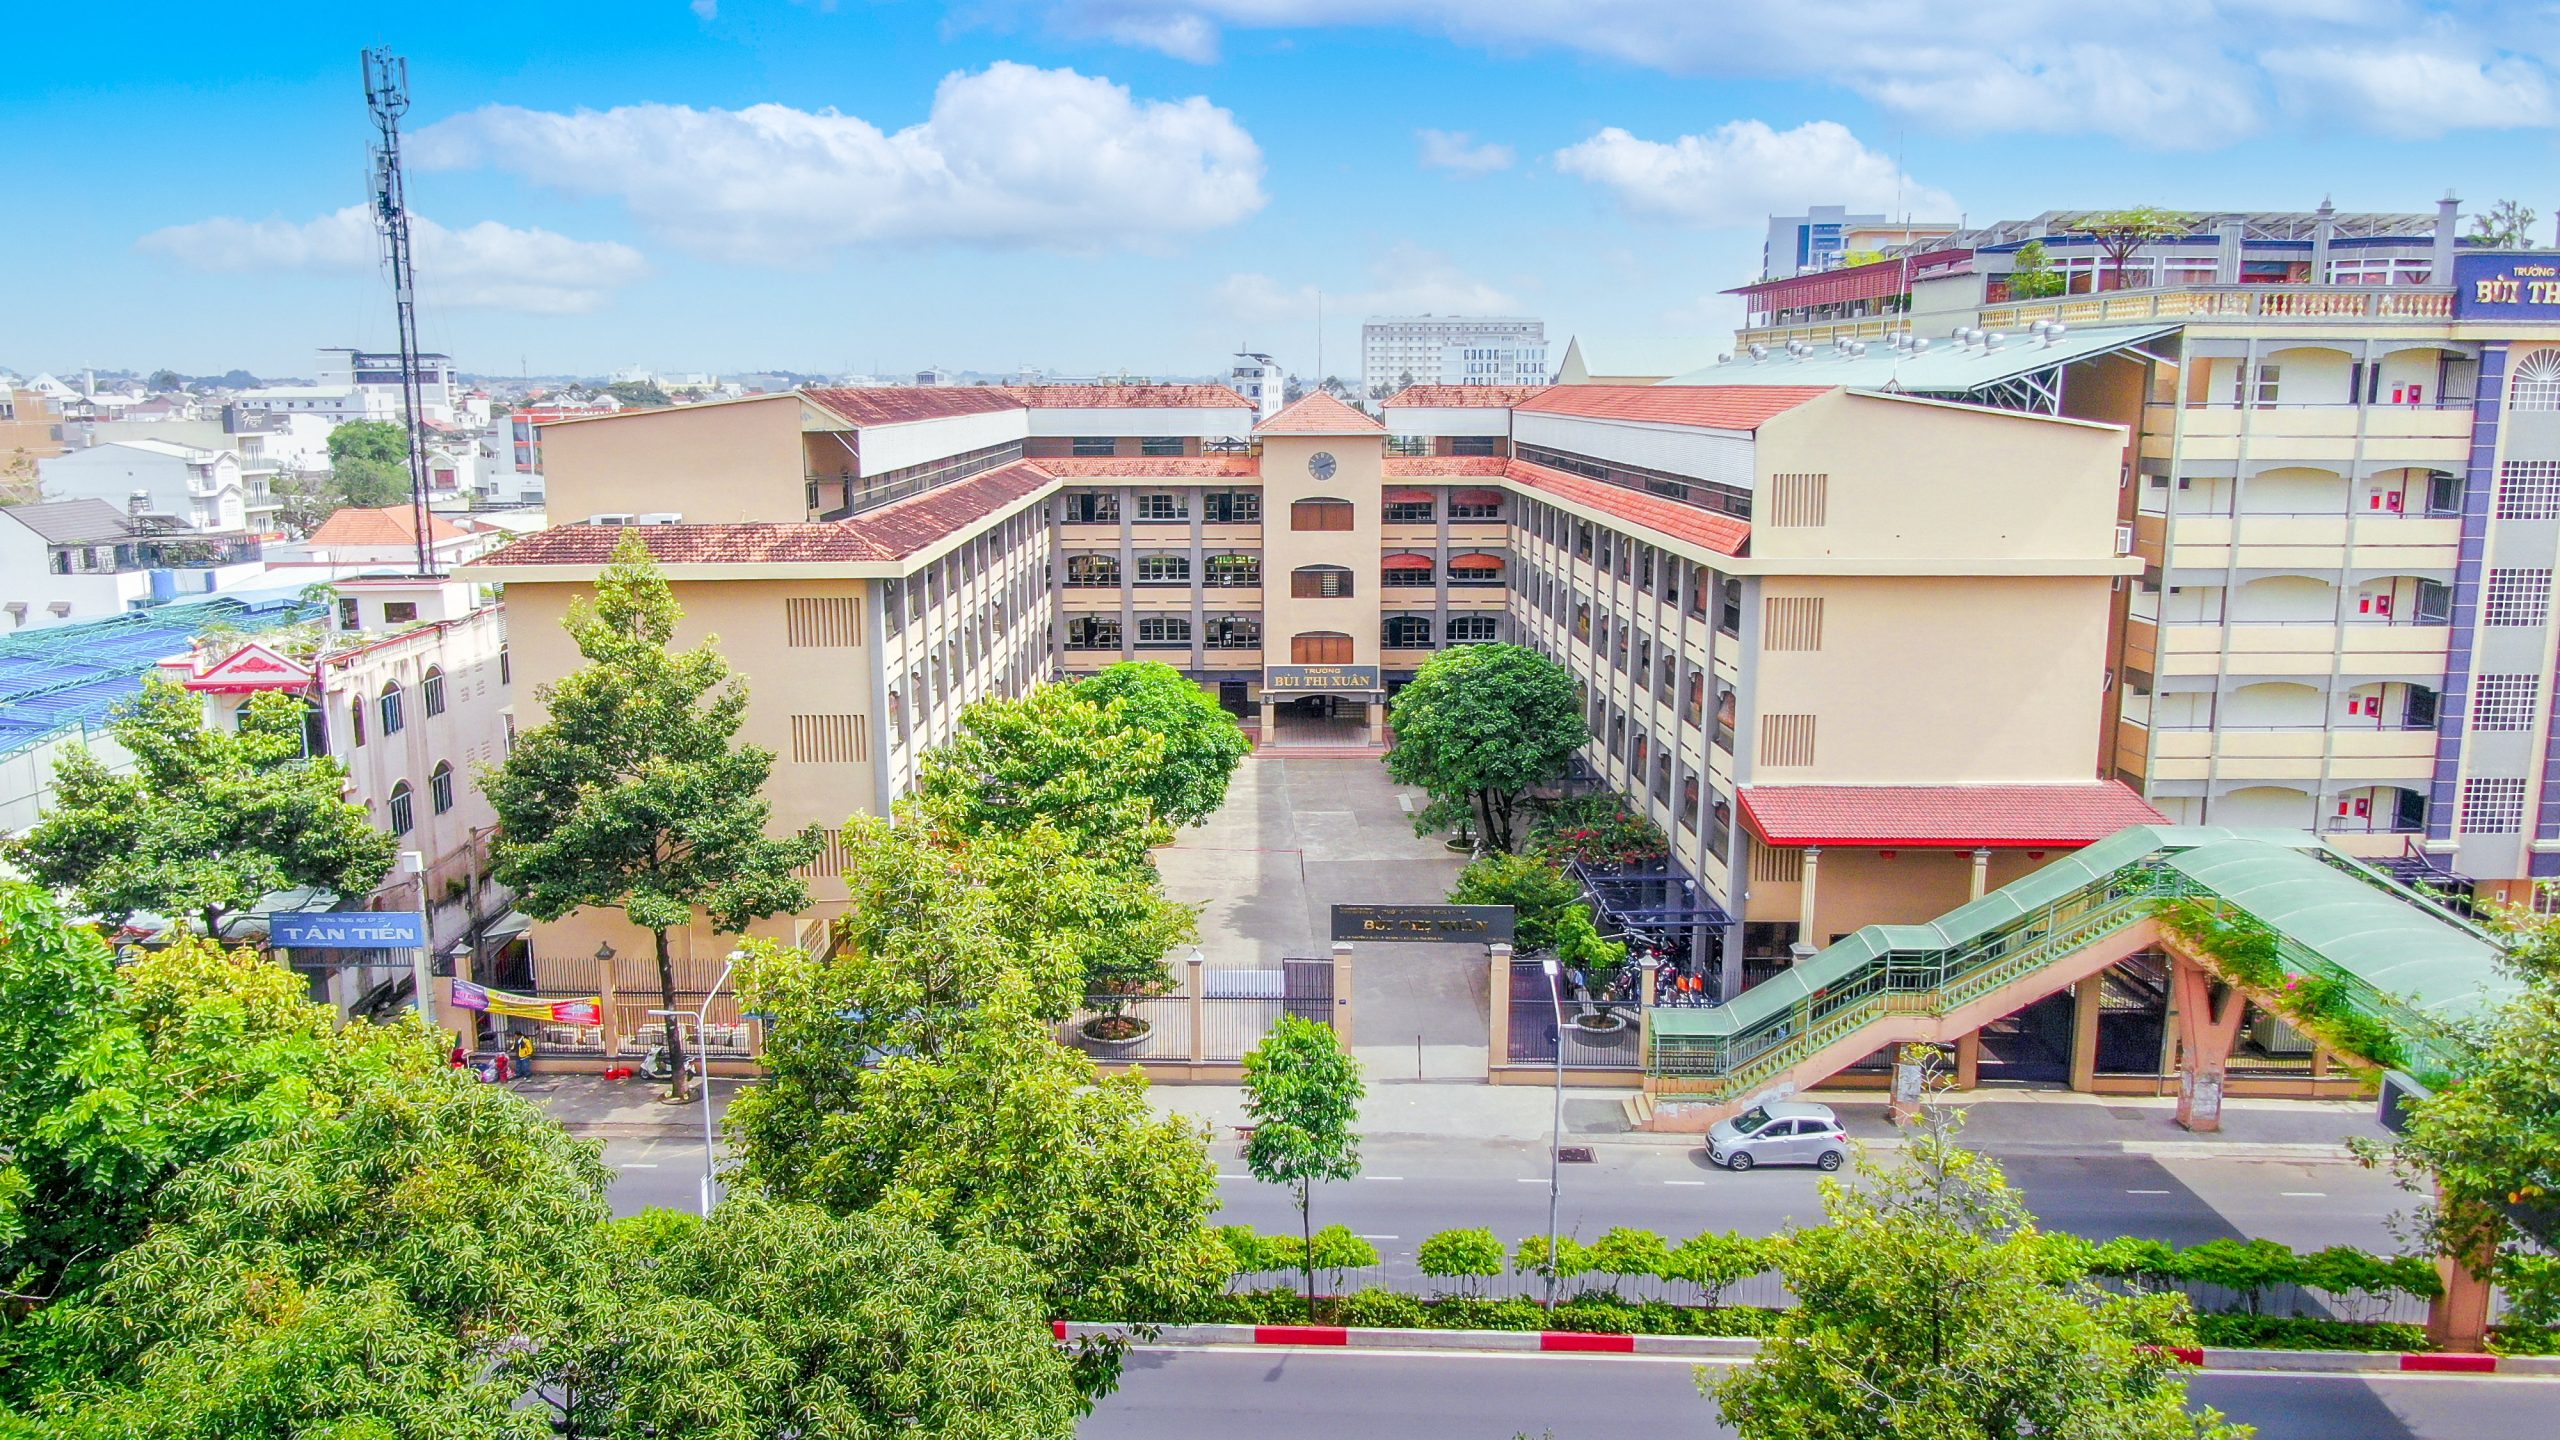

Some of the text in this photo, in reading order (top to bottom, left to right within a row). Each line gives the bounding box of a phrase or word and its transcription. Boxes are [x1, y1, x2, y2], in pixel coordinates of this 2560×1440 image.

[2513, 263, 2556, 277] TRƯỜNG
[2475, 274, 2520, 304] BÙI
[1304, 666, 1341, 674] TRƯỜNG
[1275, 673, 1370, 688] BÙI THỊ XUÂN
[282, 922, 414, 940] TÂN TIẾN
